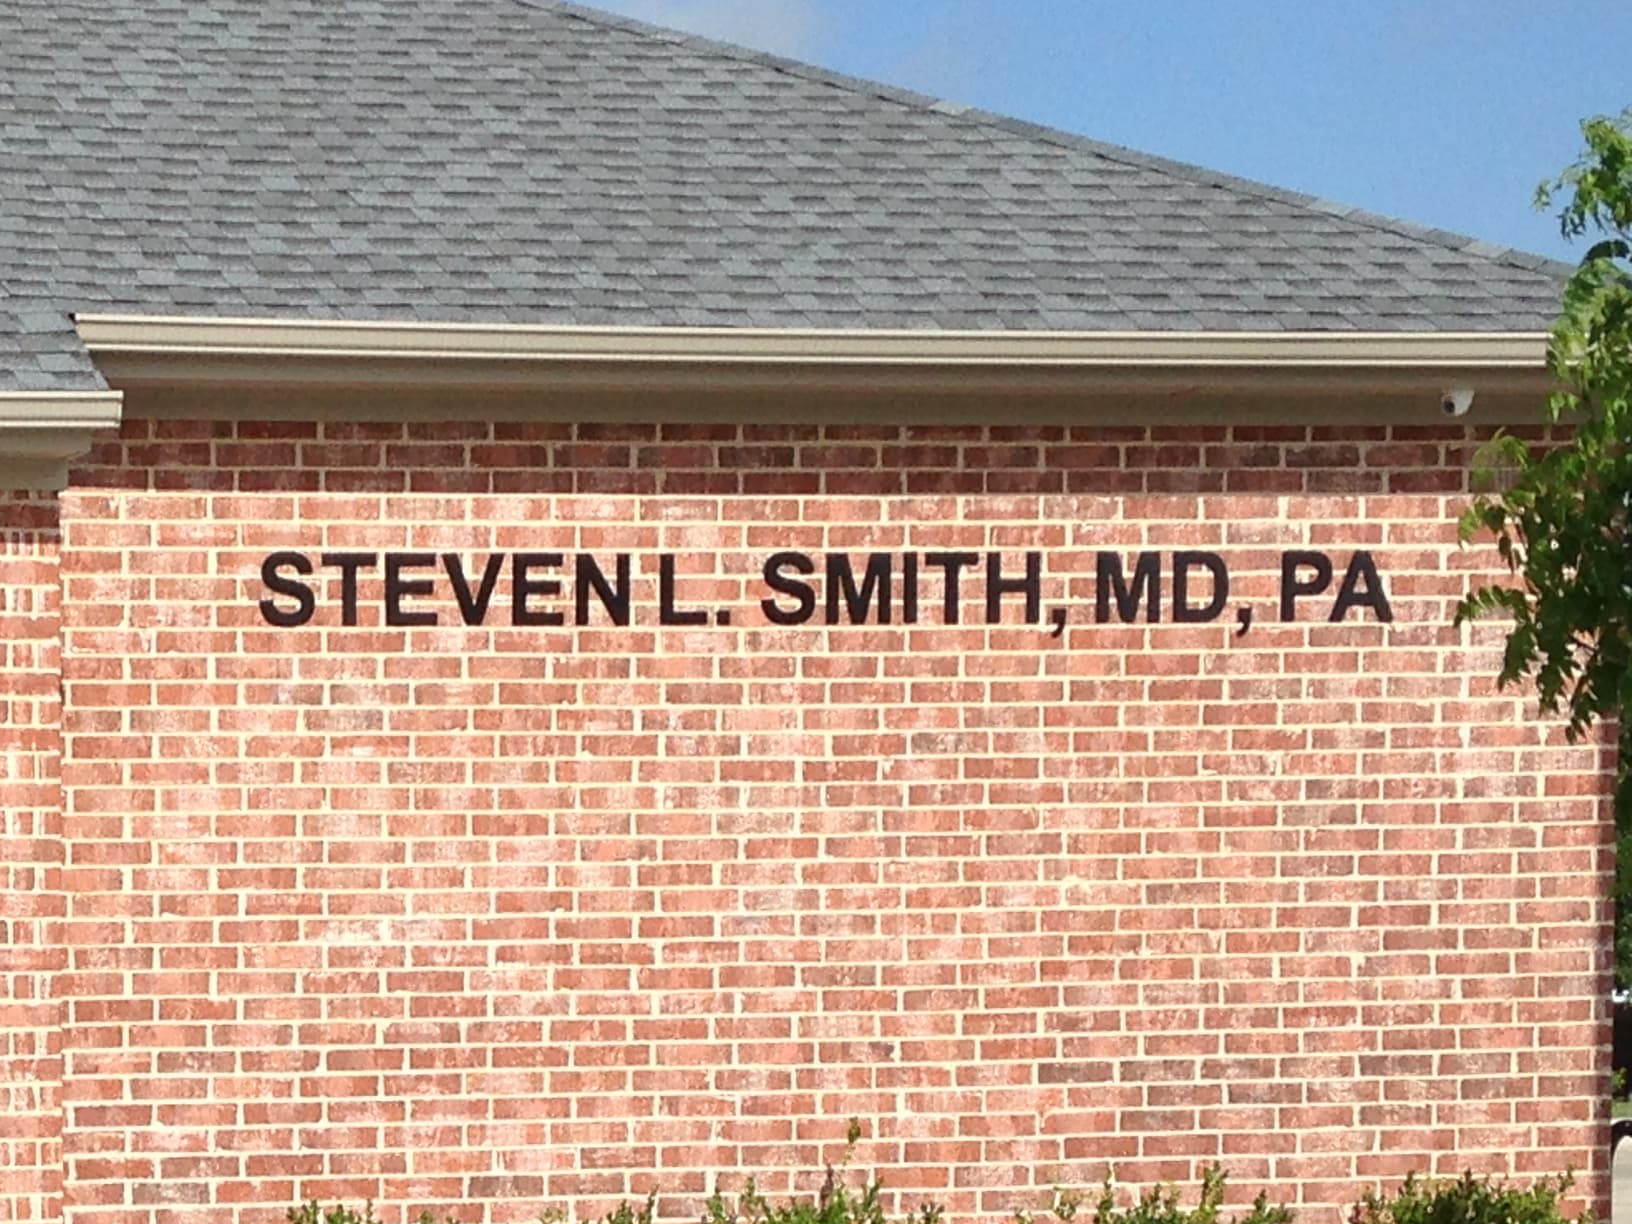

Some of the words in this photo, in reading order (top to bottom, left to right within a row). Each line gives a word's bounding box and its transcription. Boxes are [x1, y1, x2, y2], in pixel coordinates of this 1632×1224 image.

[259, 551, 631, 627] STEVEN
[658, 552, 731, 627] L.
[760, 550, 1067, 638] SMITH,
[1094, 550, 1252, 636] MD,
[1279, 550, 1394, 625] PA
